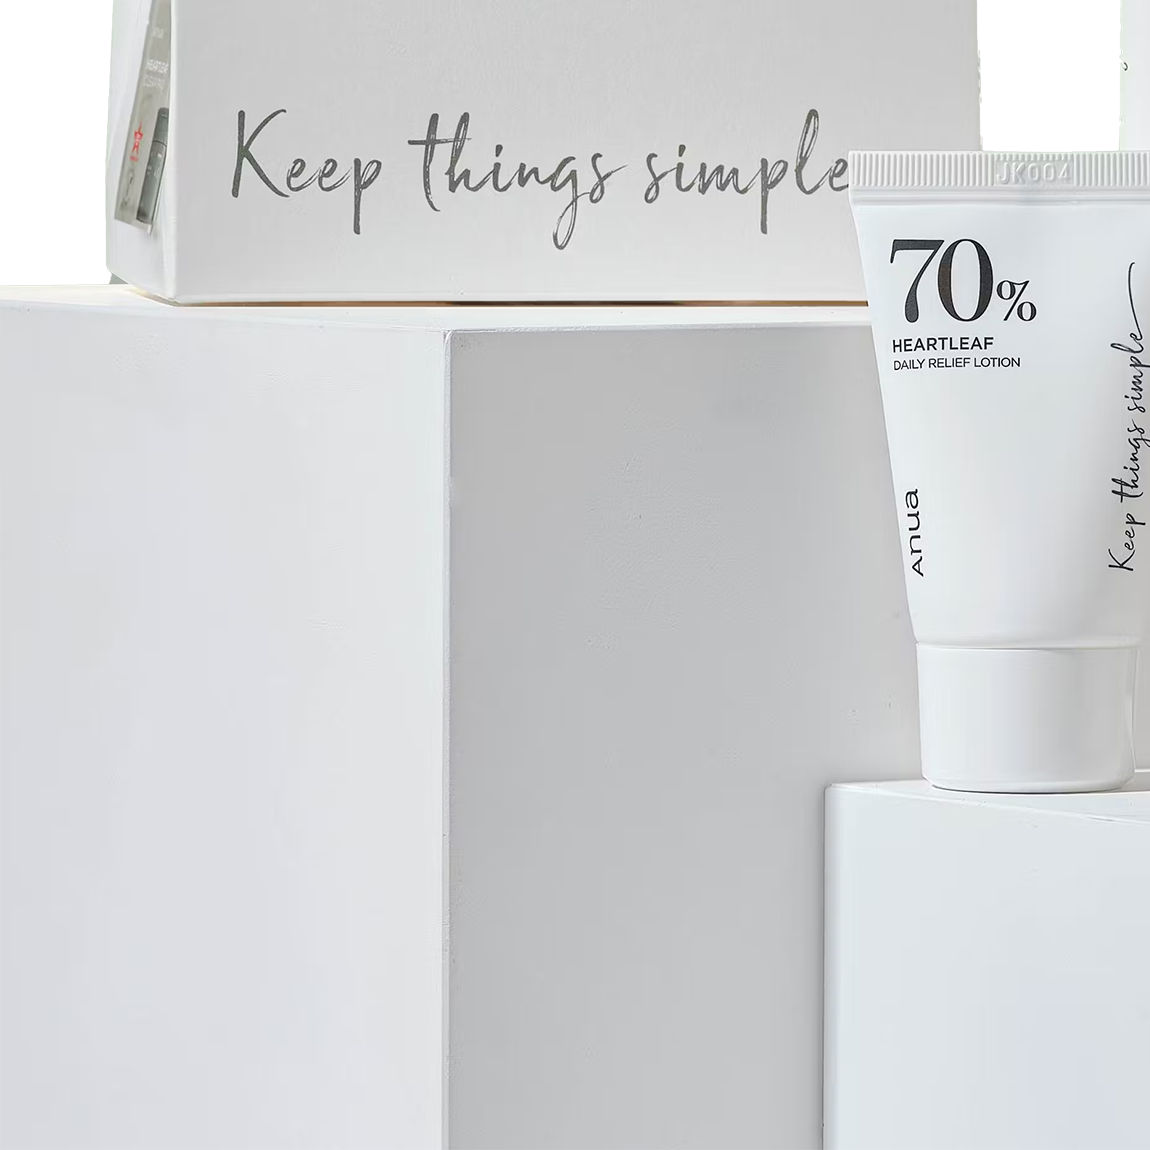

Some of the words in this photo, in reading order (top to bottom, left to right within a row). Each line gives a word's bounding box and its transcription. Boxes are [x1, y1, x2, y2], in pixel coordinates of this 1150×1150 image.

[232, 109, 381, 235] Keep
[408, 112, 625, 250] things
[645, 109, 849, 234] simple
[890, 239, 1036, 323] 70%
[893, 337, 993, 353] HEARTLEAF
[894, 359, 925, 370] DAILY
[929, 358, 970, 368] RELIEF
[974, 357, 1020, 367] LOTION
[906, 489, 923, 577] Anua
[1108, 513, 1146, 571] Keep
